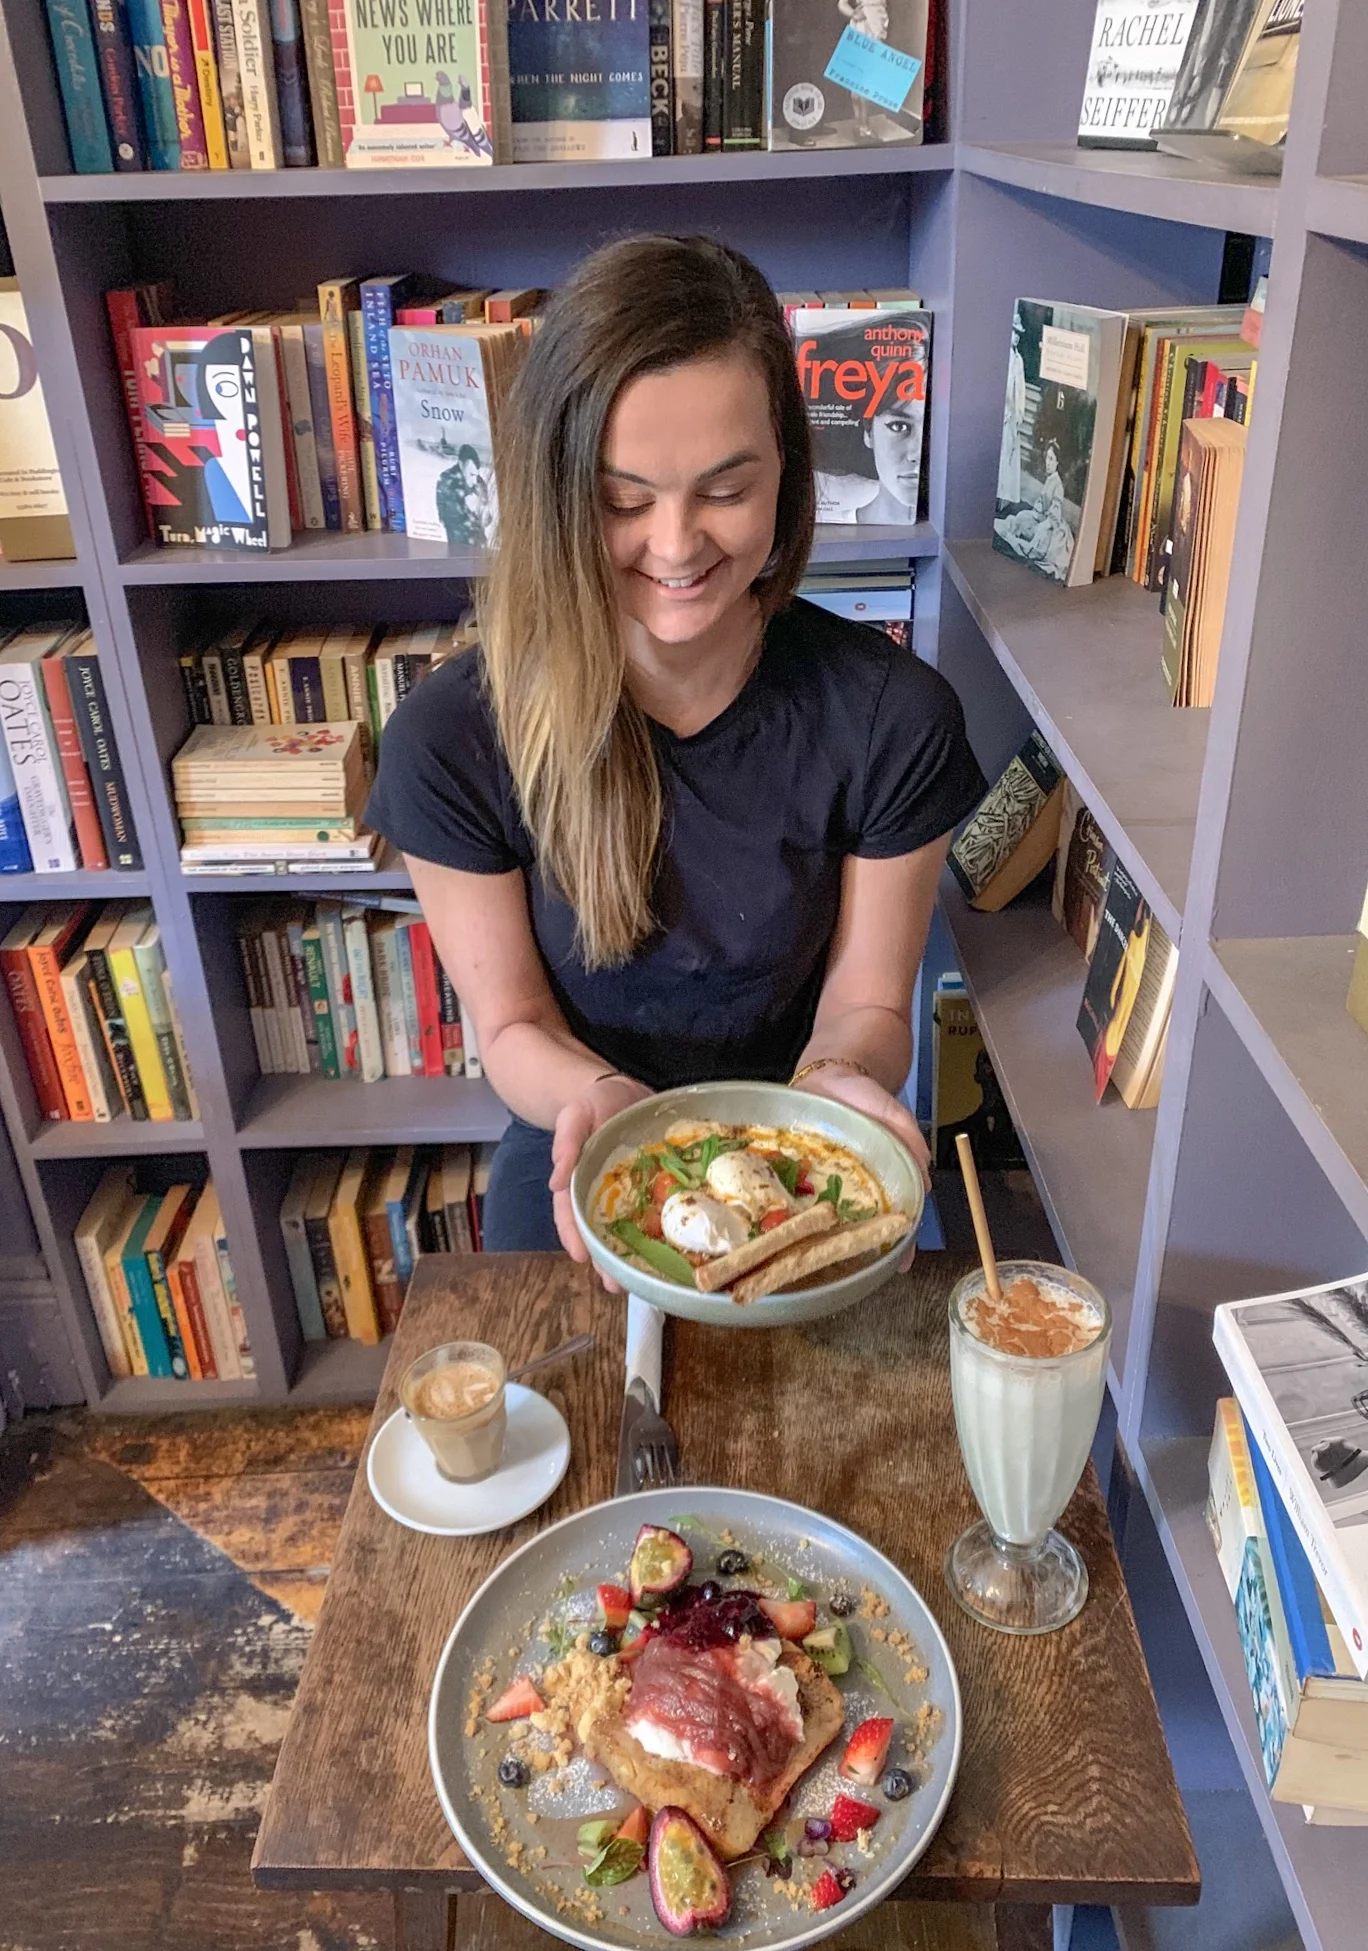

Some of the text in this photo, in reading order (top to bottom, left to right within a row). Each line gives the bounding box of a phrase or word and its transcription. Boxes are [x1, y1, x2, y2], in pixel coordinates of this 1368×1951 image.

[357, 0, 473, 28] NEWS WHERE
[1098, 12, 1185, 48] RACHEL
[239, 10, 260, 77] Soldier
[383, 33, 457, 65] YOU ARE
[731, 33, 742, 90] MANUAL
[846, 31, 917, 73] BLUE ANGEL
[203, 68, 214, 108] Destiny
[570, 71, 602, 83] NIGHT
[609, 70, 644, 83] COMES
[651, 45, 670, 115] BECK
[252, 113, 265, 143] Parker
[1080, 96, 1167, 129] SEIFFER
[363, 292, 382, 390] INLAND SEA
[374, 292, 387, 327] FISH
[381, 355, 393, 390] SETO
[409, 342, 463, 361] ORHAN
[864, 324, 926, 346] anthony
[870, 341, 912, 361] quinn
[240, 337, 256, 404] DAWN
[331, 351, 351, 414] Leopard's
[400, 359, 480, 390] PAMUK
[797, 340, 925, 418] freya
[336, 414, 351, 444] Wife
[421, 399, 465, 423] Snow
[247, 414, 266, 518] POWELL
[337, 450, 351, 499] PICKERING
[379, 442, 391, 486] PILGRIM
[350, 664, 362, 703] ANNIE
[396, 663, 406, 692] MANUEL
[0, 680, 32, 766] OATES
[20, 680, 47, 764] JOYCE CAROL
[78, 666, 112, 771] JOYCE CAROL OATES
[105, 781, 127, 843] MUDWOMAN
[304, 945, 320, 989] RENAULT
[376, 942, 391, 998] DARK BRIDE
[442, 974, 454, 1023] DREAMING
[948, 1026, 981, 1036] RUP
[1290, 1487, 1329, 1577] William Trevor
